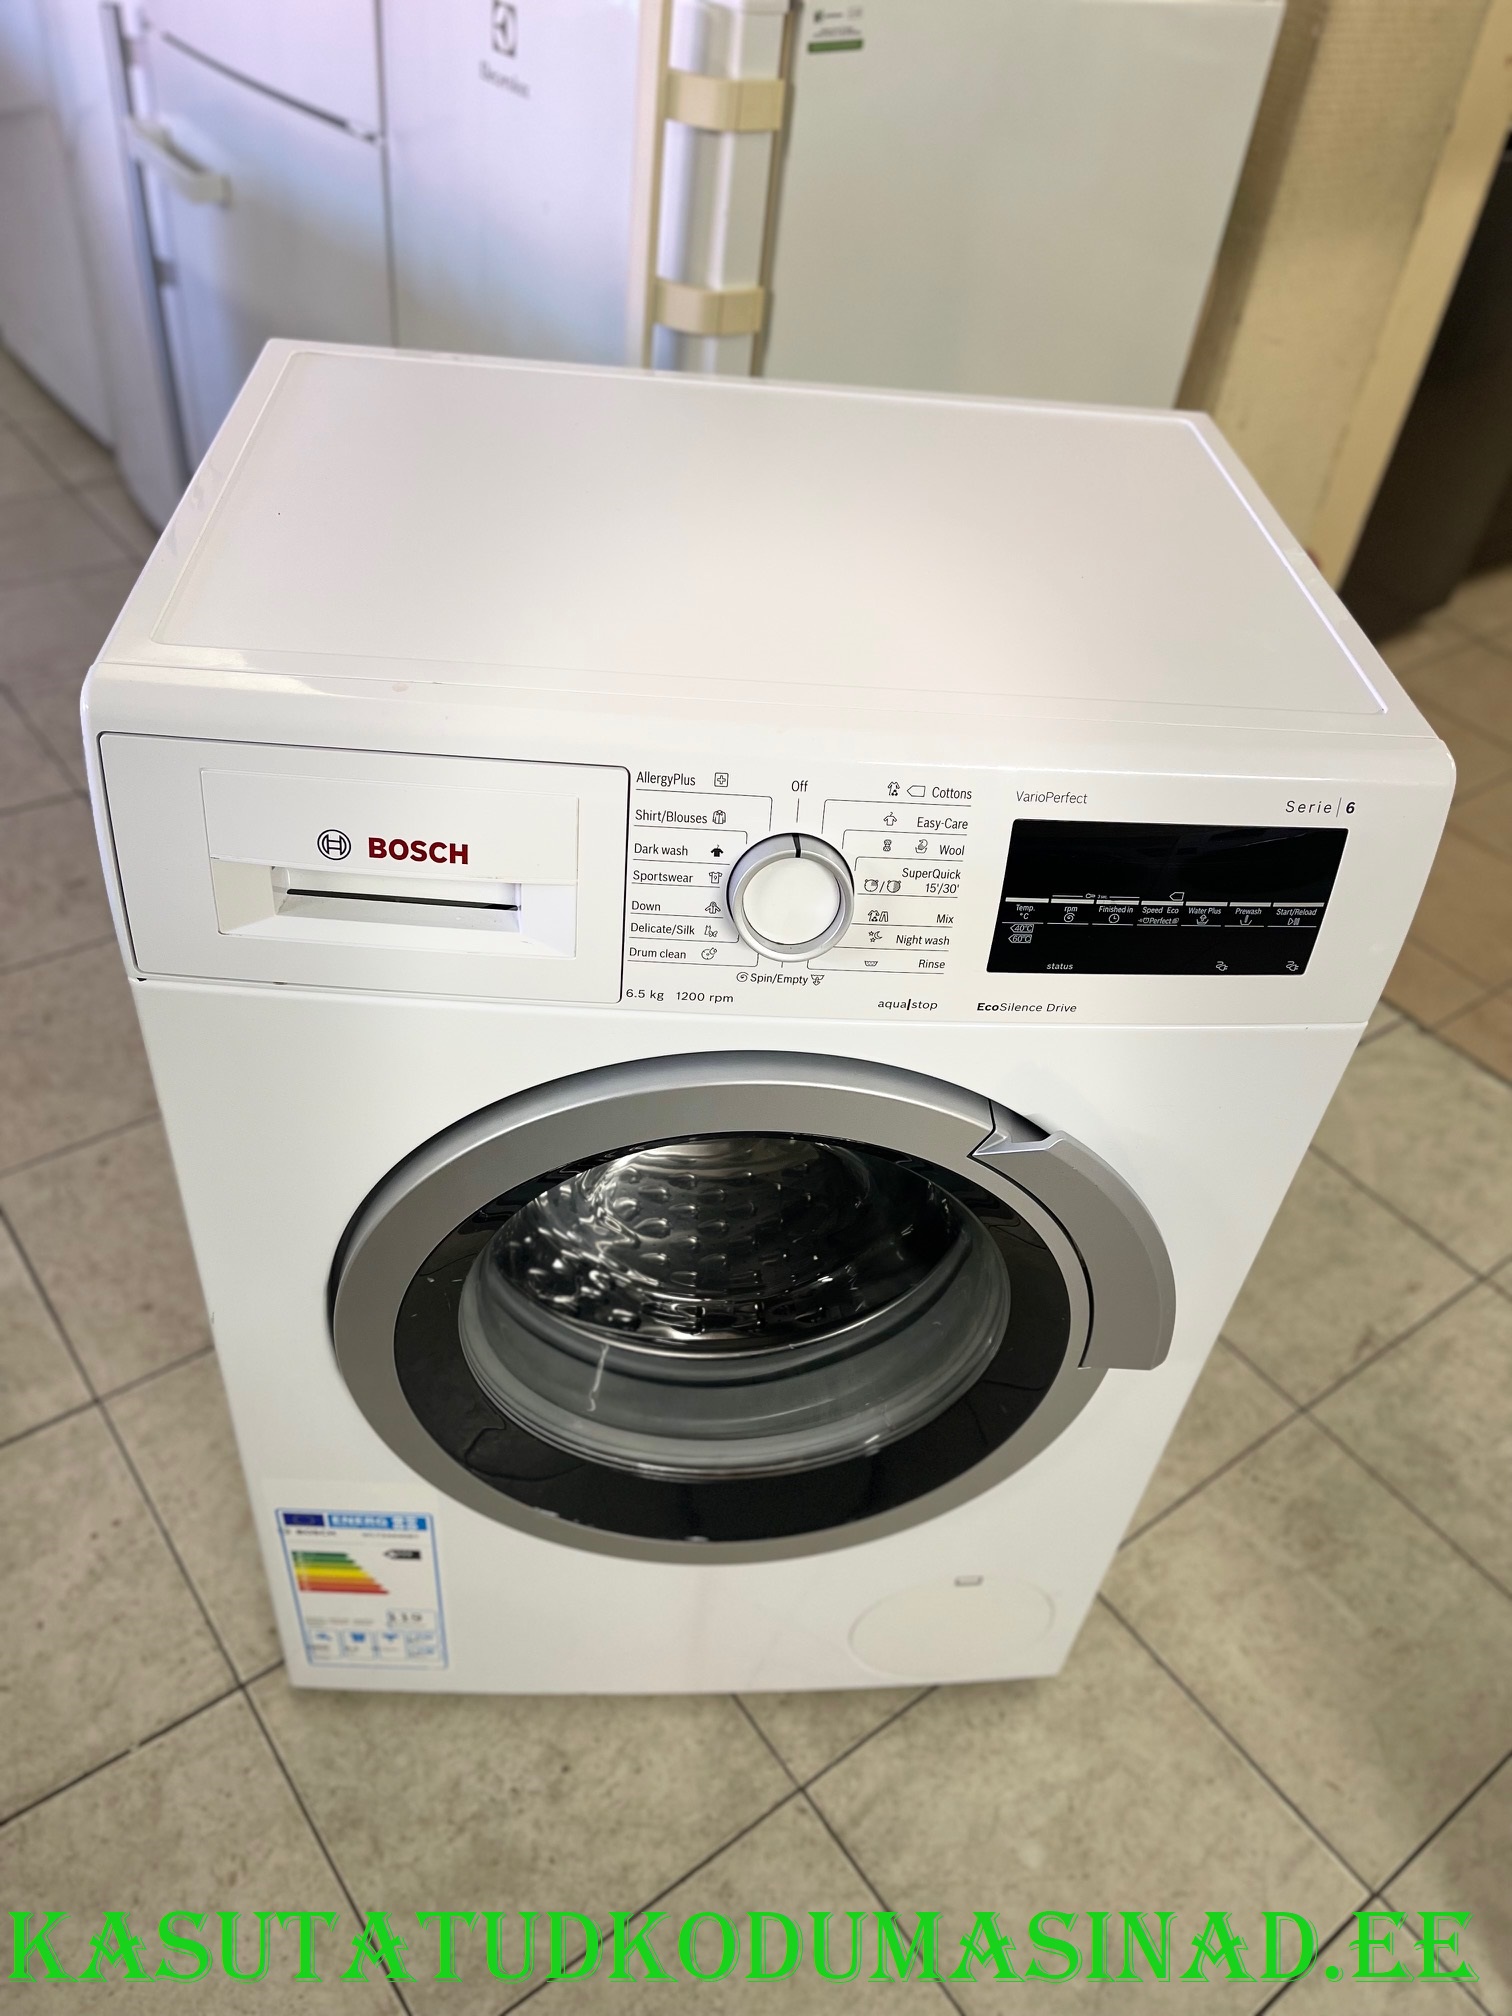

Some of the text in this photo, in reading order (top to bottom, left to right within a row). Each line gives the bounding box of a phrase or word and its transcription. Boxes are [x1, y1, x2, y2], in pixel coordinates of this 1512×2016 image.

[636, 771, 696, 787] AllergyPlus
[791, 780, 808, 792] Off
[932, 787, 972, 800] Cottons
[1016, 790, 1088, 804] VarioPerfect
[1285, 800, 1355, 814] Serie 6
[635, 809, 708, 824] Shirt/Blouses
[917, 817, 968, 830] Easy-Care
[368, 837, 469, 865] BOSCH
[634, 843, 688, 856] Dark wash
[939, 845, 965, 856] Wool
[632, 870, 693, 883] Sportswear
[902, 868, 961, 881] SuperQuick
[631, 900, 661, 912] Down
[1016, 904, 1035, 912] Temp.
[1142, 907, 1163, 915] Speed
[1276, 908, 1317, 916] Start/Reload
[936, 914, 954, 924] Mix
[1149, 917, 1172, 925] Perfect
[630, 922, 695, 935] Delicate/Silk
[896, 935, 950, 946] Night wash
[629, 947, 686, 959] Drum clean
[918, 959, 945, 969] Rinse
[750, 973, 809, 986] Spin/Empty
[626, 989, 733, 1004] 6.5 kg 1200 rpm
[977, 1003, 1077, 1012] EcoSilence Drive
